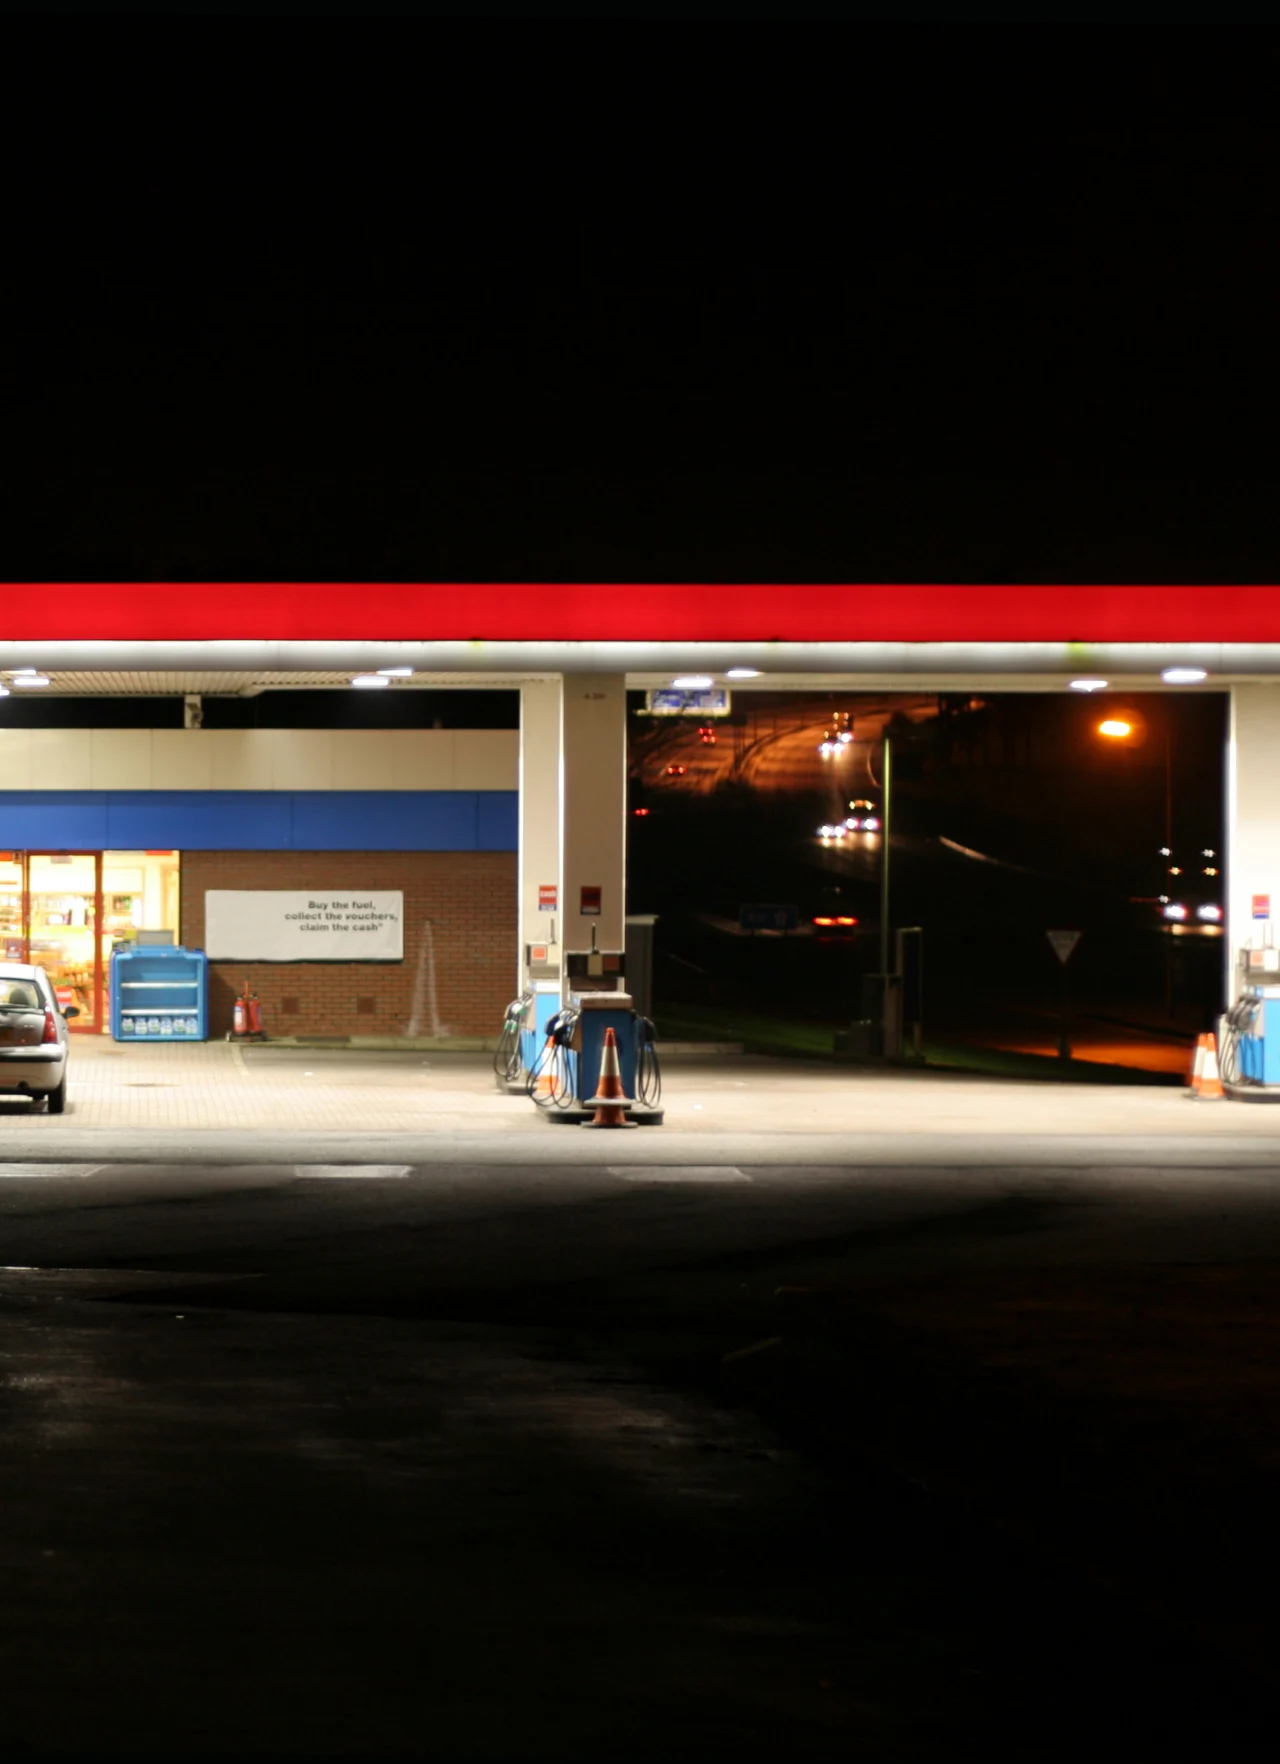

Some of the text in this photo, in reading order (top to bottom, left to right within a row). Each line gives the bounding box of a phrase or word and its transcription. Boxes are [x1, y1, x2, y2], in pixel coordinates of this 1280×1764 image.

[308, 900, 376, 910] Buy the fuel,
[284, 912, 398, 922] collect the vouchers,
[300, 923, 329, 931] claim
[332, 923, 350, 931] the
